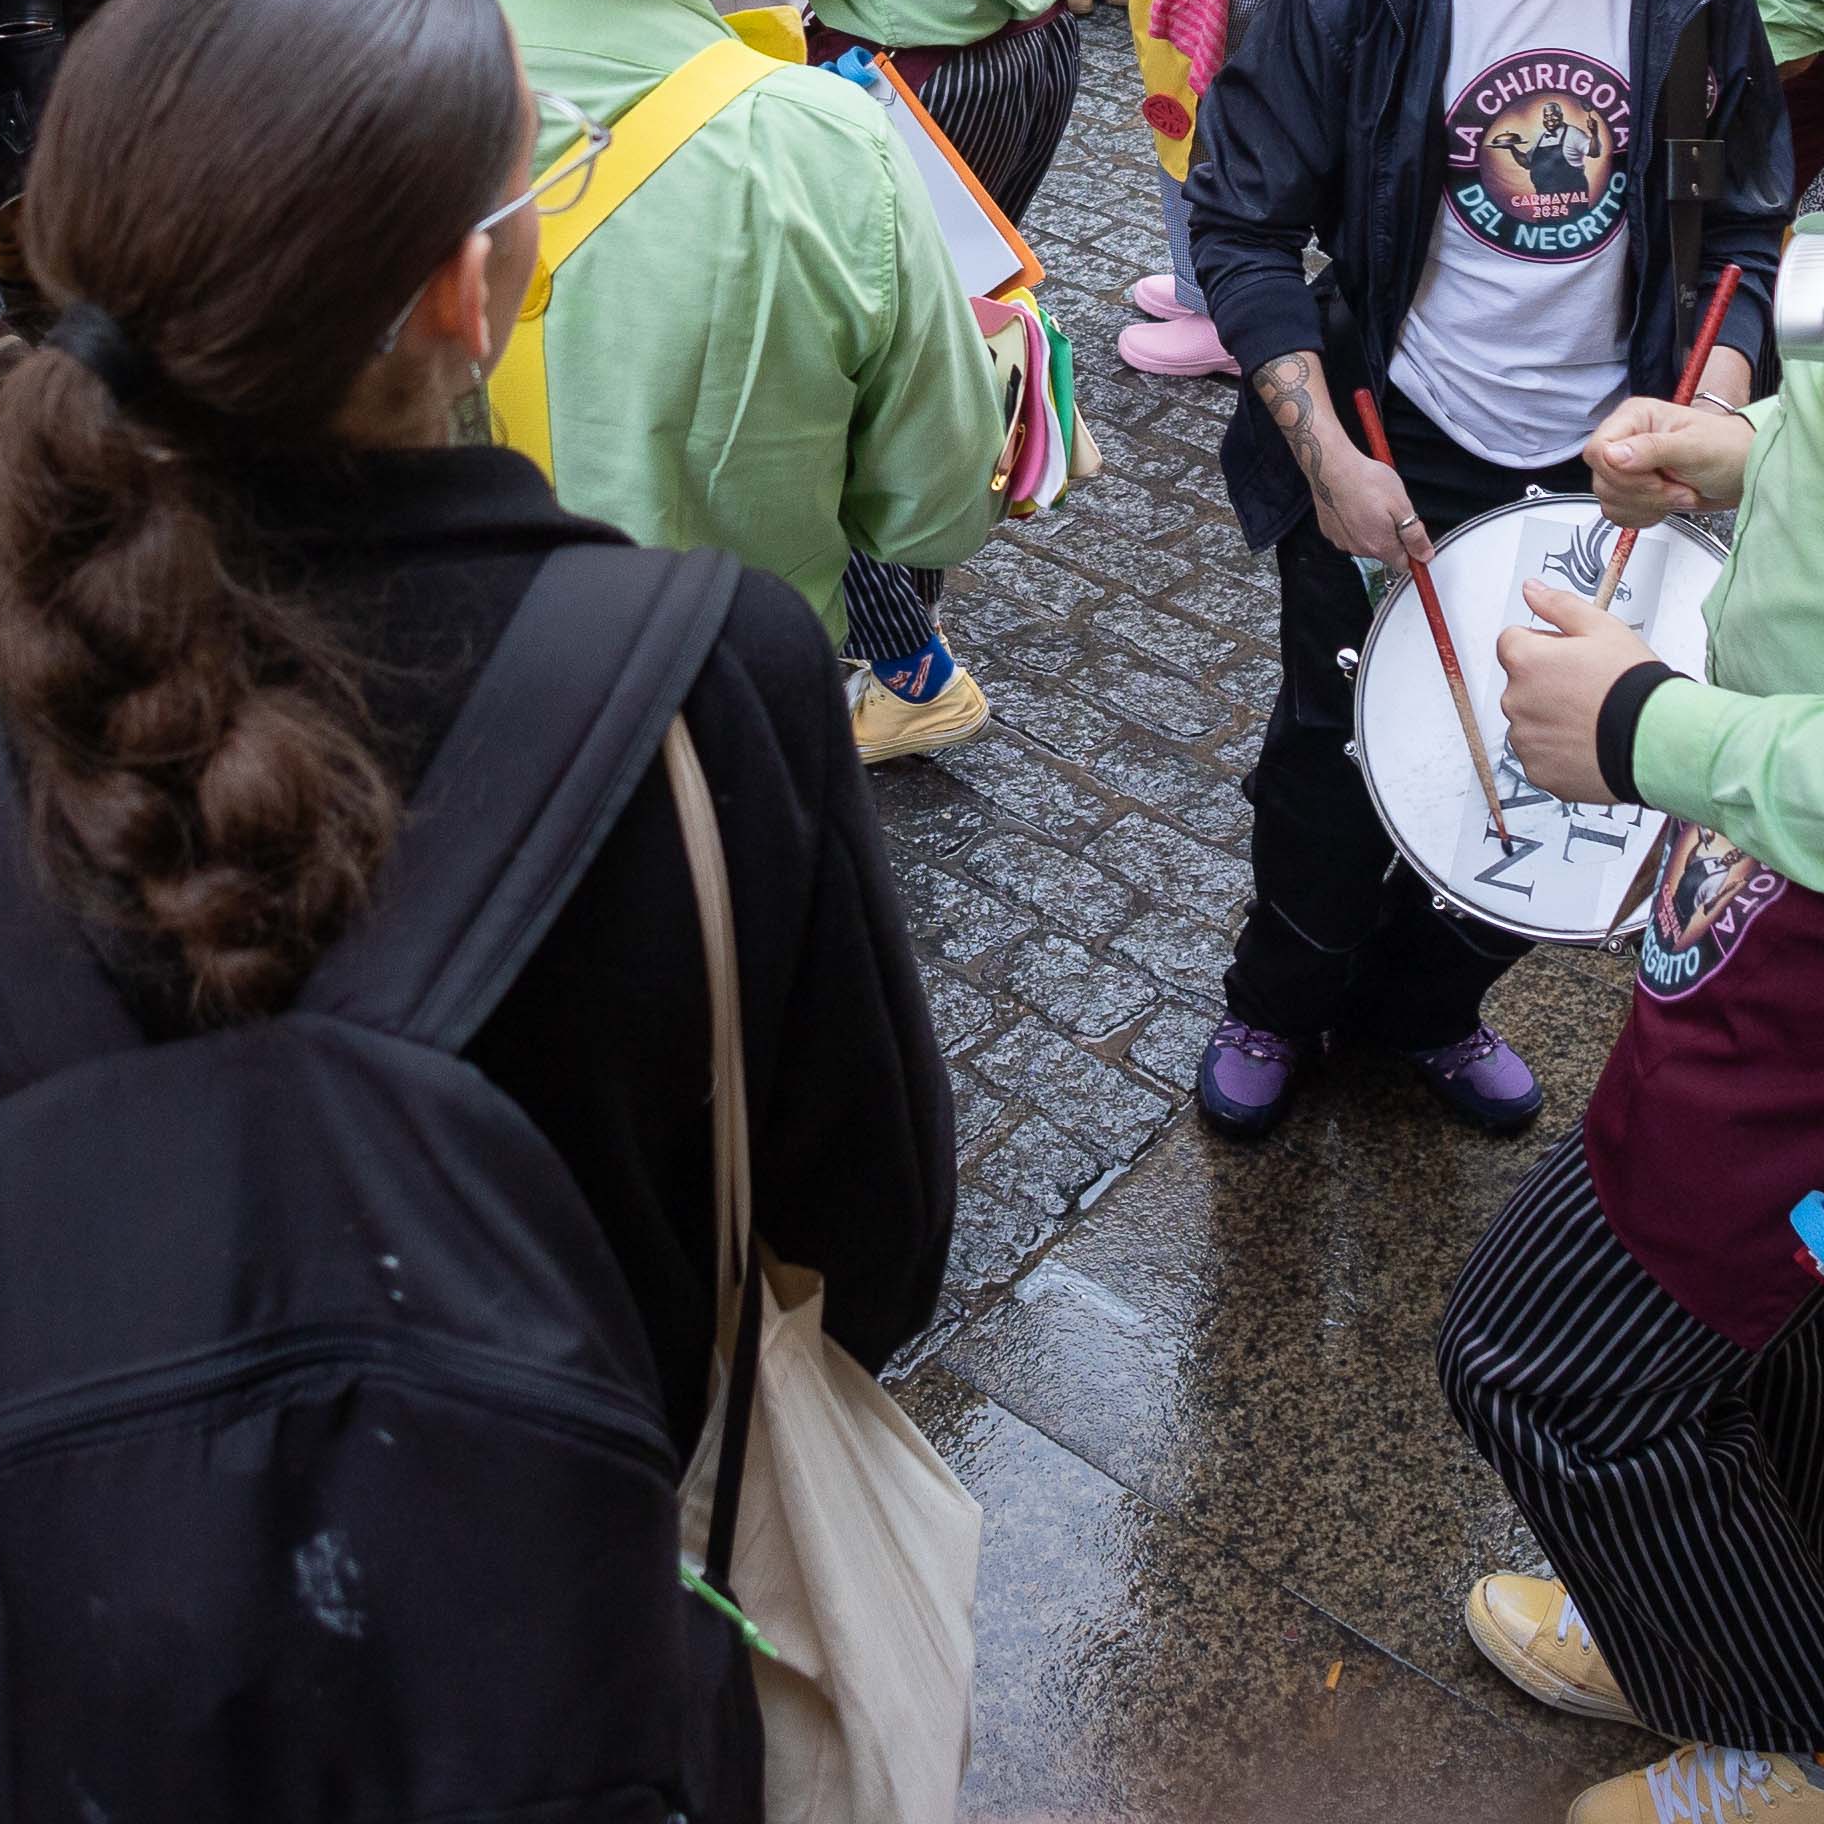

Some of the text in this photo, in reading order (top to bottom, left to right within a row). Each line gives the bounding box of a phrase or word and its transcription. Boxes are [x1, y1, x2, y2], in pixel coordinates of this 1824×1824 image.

[1448, 125, 1483, 163] LA
[1476, 62, 1631, 147] CHIRIGOTA
[1456, 171, 1628, 251] DEL NEGRITO
[1510, 192, 1589, 208] CARNAVAL
[1532, 204, 1569, 218] 2024
